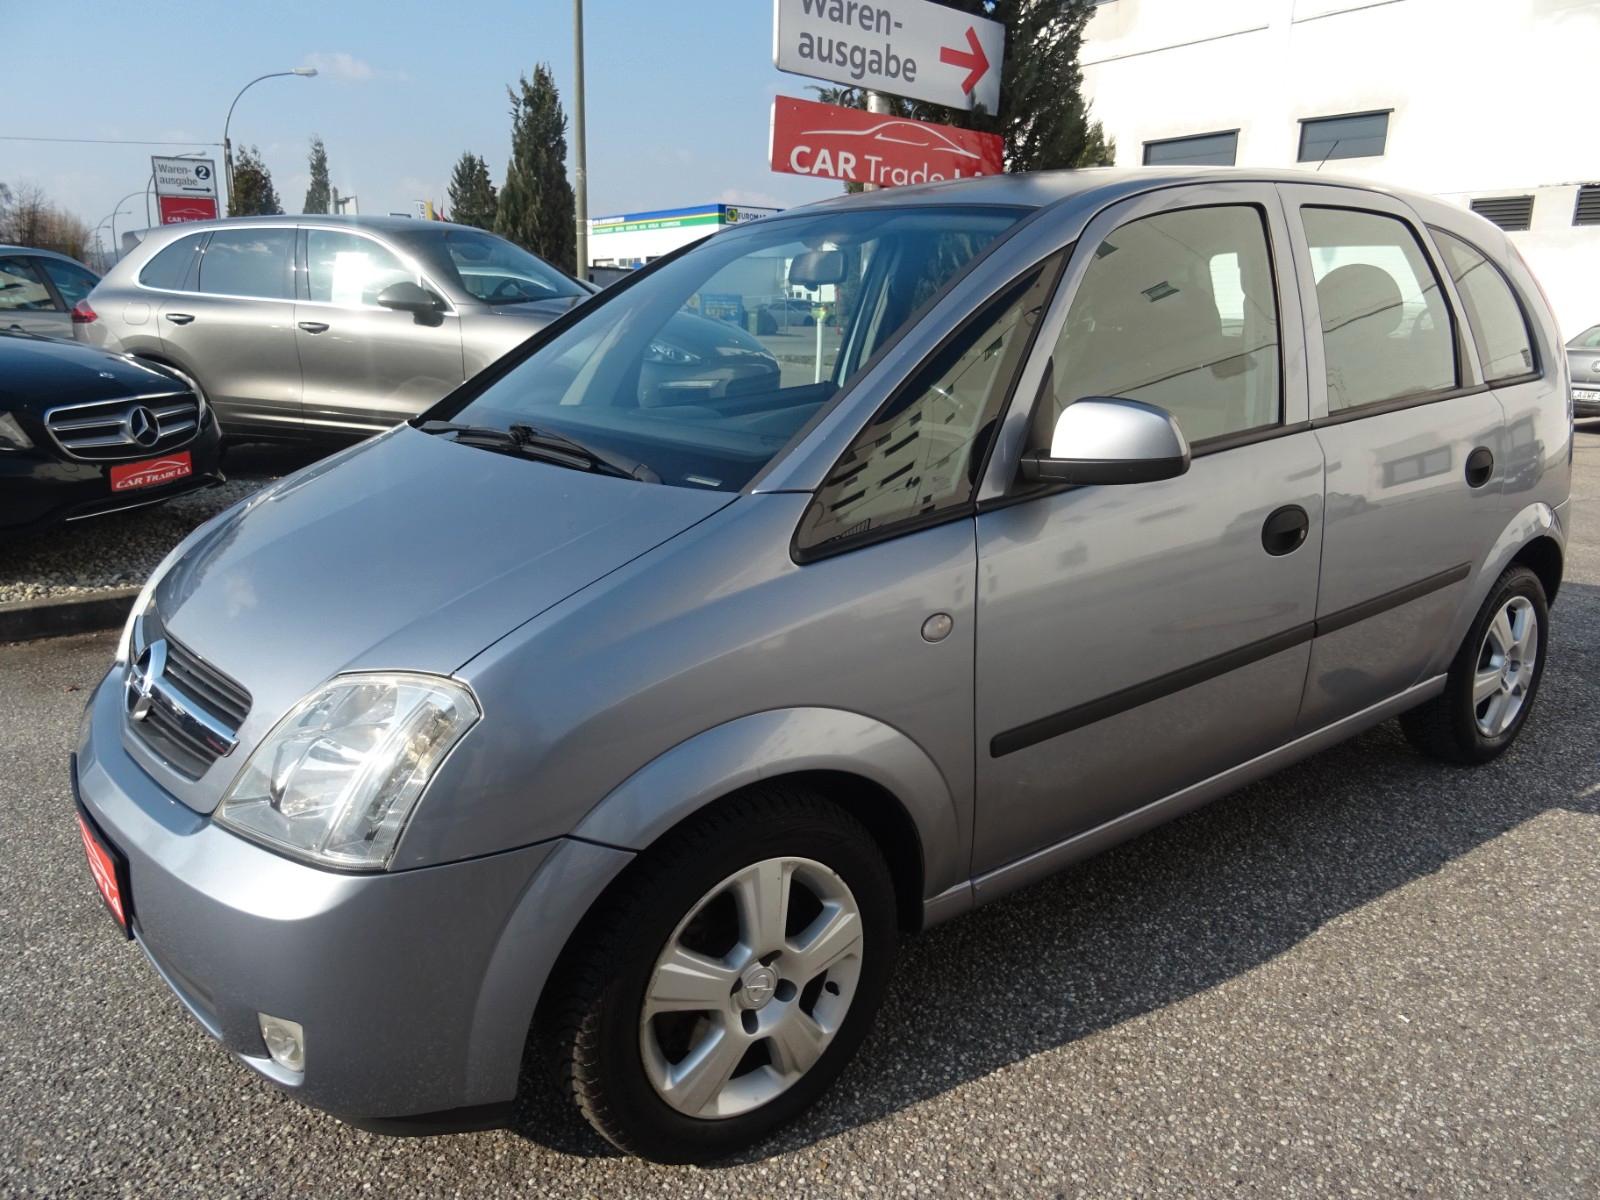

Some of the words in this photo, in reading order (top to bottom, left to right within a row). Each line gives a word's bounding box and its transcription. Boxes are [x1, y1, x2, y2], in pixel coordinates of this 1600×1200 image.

[798, 31, 917, 83] ausgabe
[158, 164, 192, 174] Waren-
[790, 145, 857, 180] CAR
[160, 176, 198, 187] ausgabe
[198, 166, 208, 180] 2
[116, 476, 144, 489] CAR
[177, 465, 190, 475] LA
